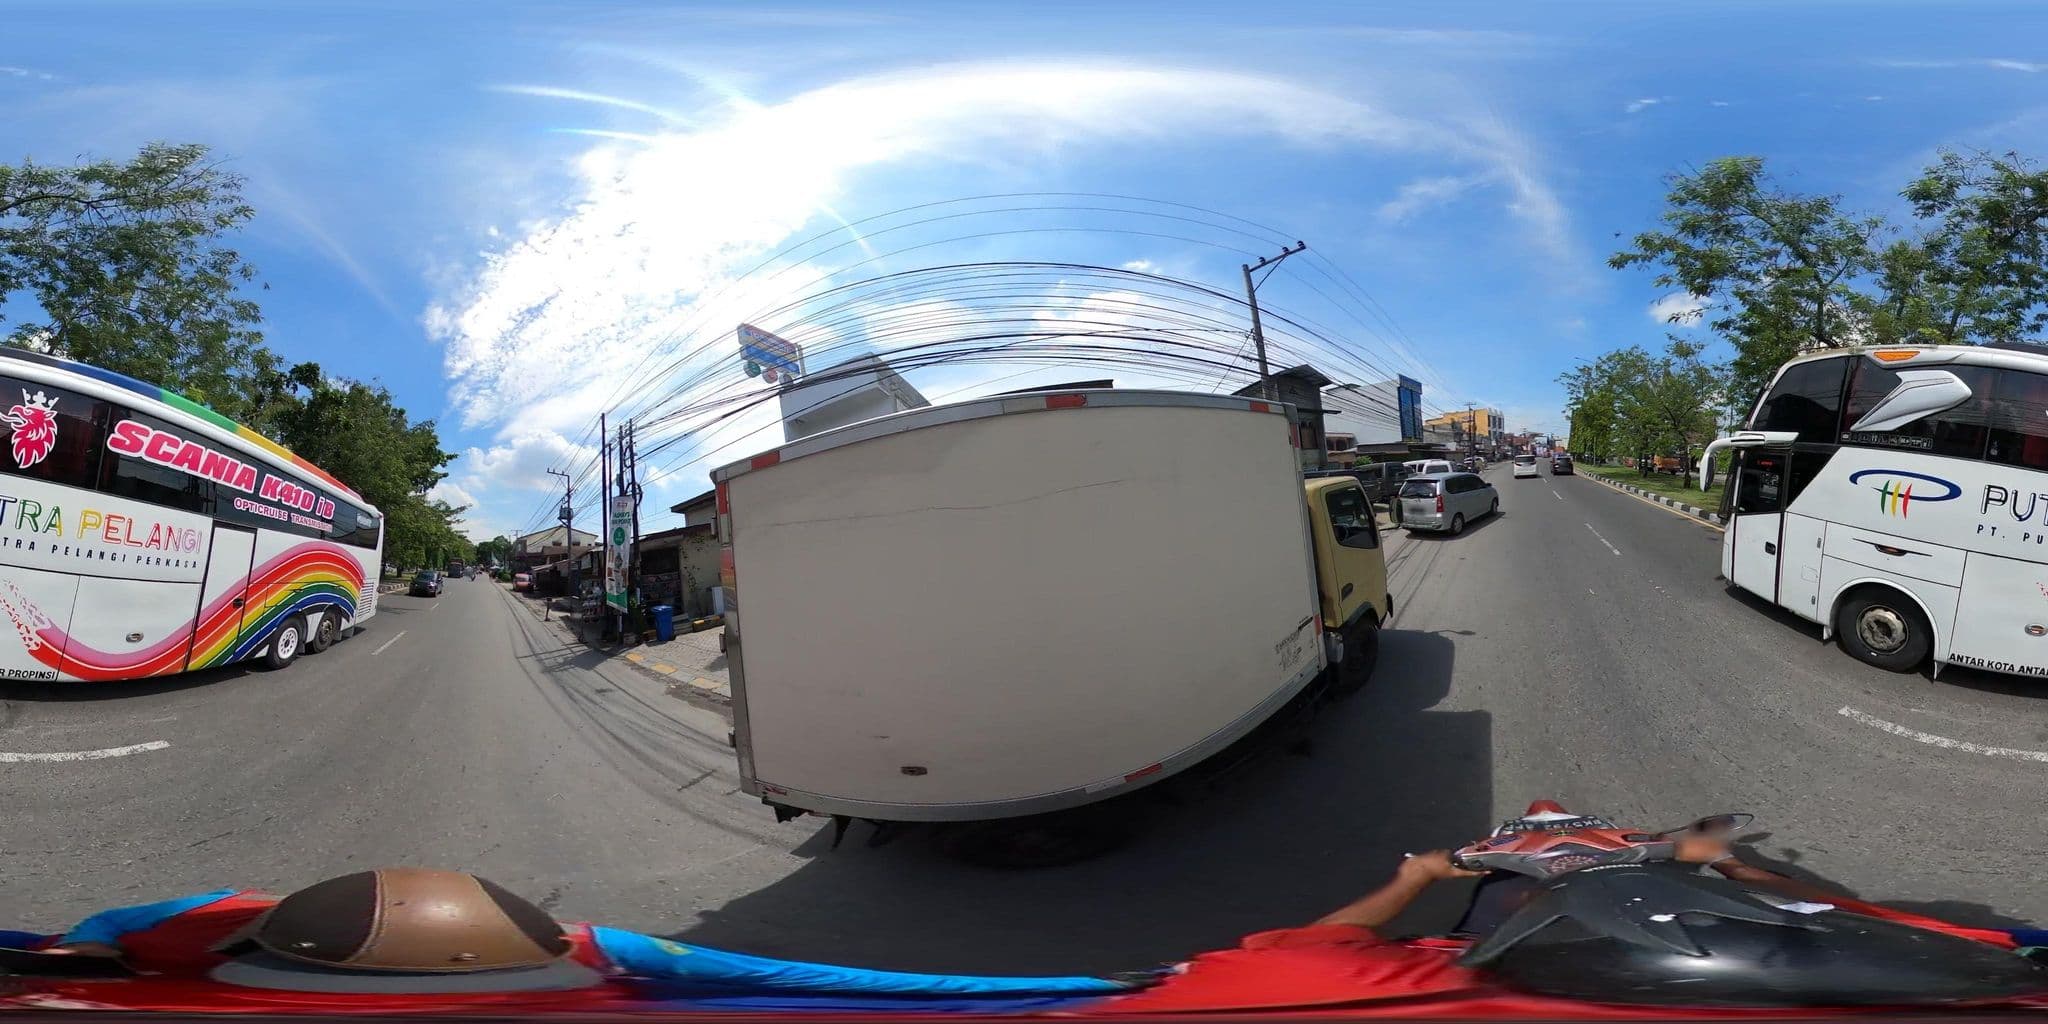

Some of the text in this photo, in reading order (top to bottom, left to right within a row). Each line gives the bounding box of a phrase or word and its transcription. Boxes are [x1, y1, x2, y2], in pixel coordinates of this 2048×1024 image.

[107, 420, 336, 520] SCANIA K410 iB
[234, 497, 288, 521] OPTICRUISE
[77, 509, 202, 554] PELANGI
[1976, 524, 2005, 539] PT.
[51, 544, 126, 562] PELANGI
[136, 555, 197, 569] PERKASA
[8, 669, 56, 680] PROPINSI
[1949, 653, 2048, 676] ANTAR KOTA ANTA
